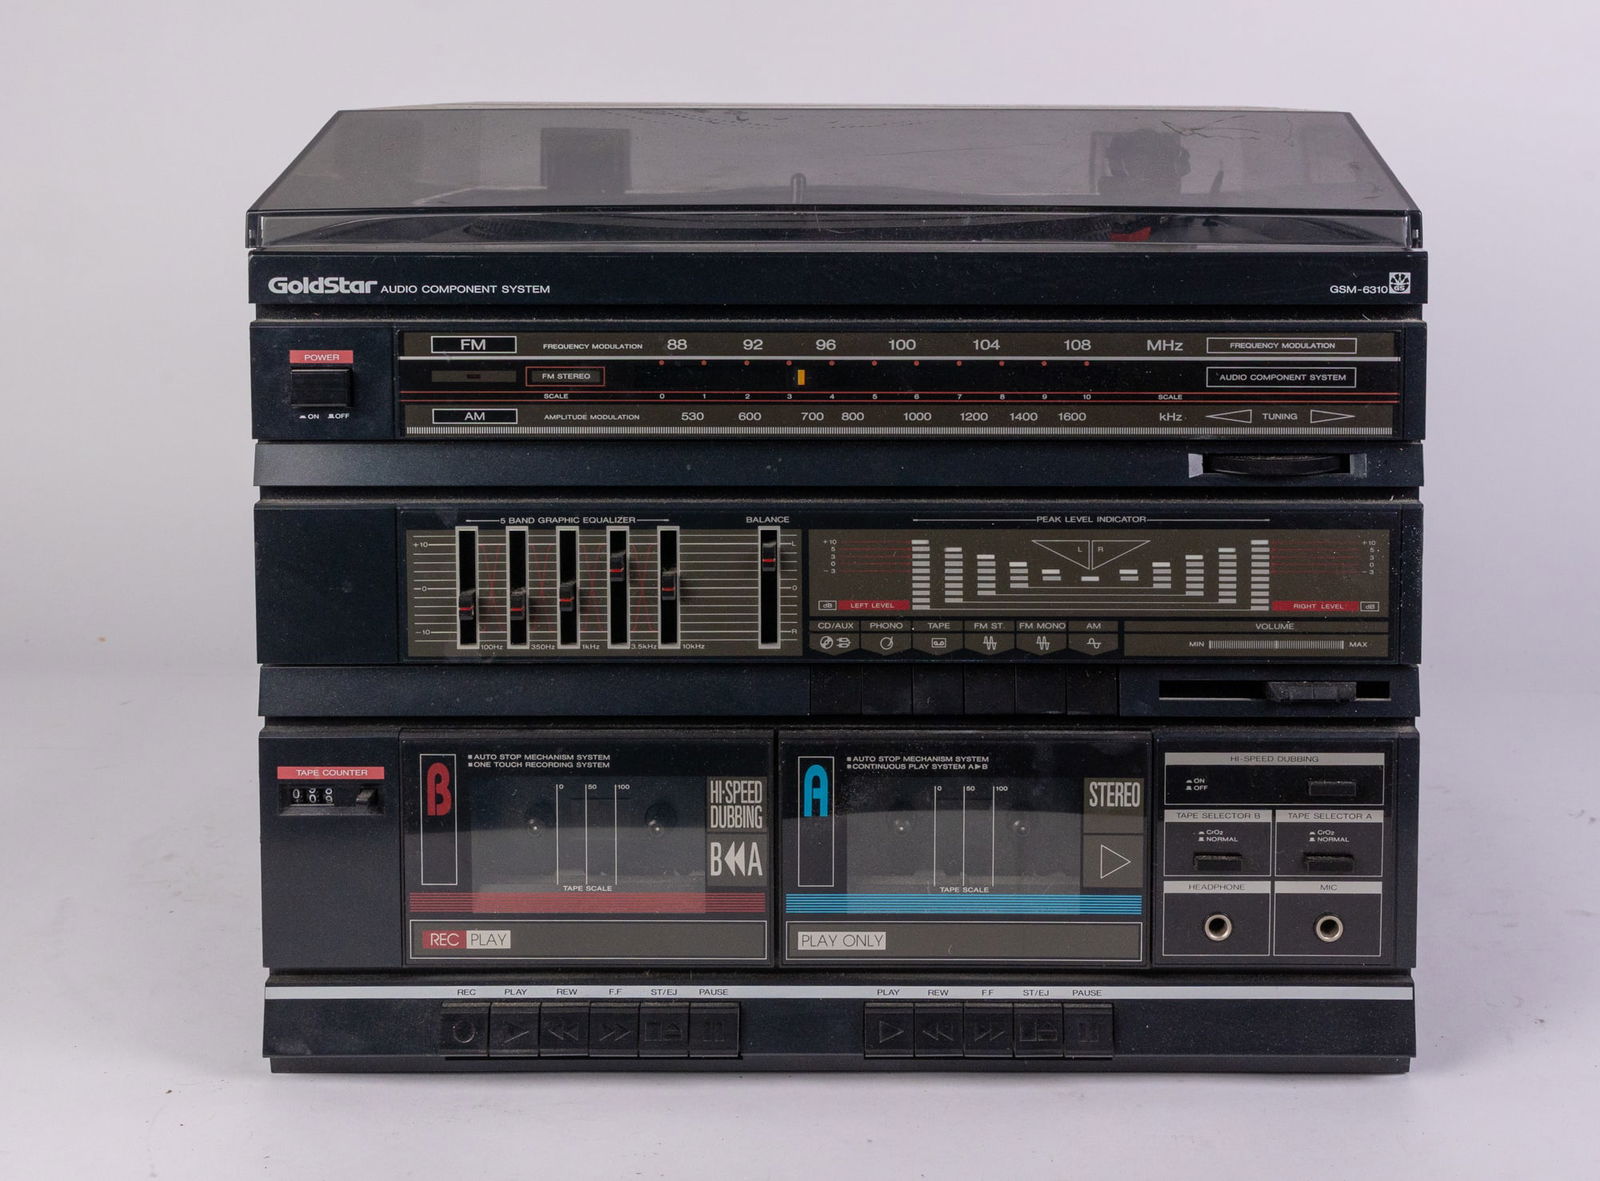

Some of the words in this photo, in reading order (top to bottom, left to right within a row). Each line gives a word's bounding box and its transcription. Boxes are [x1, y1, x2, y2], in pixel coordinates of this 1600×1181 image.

[268, 277, 378, 294] GoldStar
[380, 285, 417, 294] AUDIO
[422, 285, 497, 294] COMPONENT
[501, 285, 550, 294] SYSTEM
[1330, 285, 1388, 294] GSM-6310
[460, 339, 486, 351] FM
[543, 343, 589, 351] FREQUENCY
[667, 339, 688, 351] 88
[743, 339, 763, 351] 92
[816, 339, 836, 351] 96
[888, 339, 916, 351] 100
[972, 339, 1000, 351] 104
[1064, 339, 1091, 351] 108
[1146, 339, 1184, 351] MHz
[1230, 342, 1279, 350] FREQUENCY
[1281, 342, 1336, 350] MODULATION
[304, 353, 340, 361] POWER
[335, 412, 350, 420] OFF
[464, 412, 486, 421] AM
[544, 413, 588, 421] AMPLITUDE
[590, 413, 640, 421] MODULATION
[681, 412, 704, 421] 530
[738, 412, 761, 421] 600
[802, 412, 824, 421] 700
[841, 412, 864, 421] 800
[903, 412, 932, 421] 1000
[960, 412, 989, 421] 1200
[1009, 412, 1038, 421] 1400
[1058, 412, 1087, 421] 1600
[1159, 412, 1183, 422] kHz
[1262, 412, 1298, 421] TUNING
[582, 516, 636, 524] EQUALIZER
[746, 516, 790, 524] BALANCE
[818, 622, 854, 630] CD/AUX
[869, 622, 904, 630] PHONO
[927, 622, 950, 630] TAPE
[1036, 622, 1067, 630] MONO
[1086, 622, 1101, 630] AM
[1255, 622, 1295, 630] VOLUME
[296, 769, 320, 777] TAPE
[322, 769, 368, 777] COUNTER
[427, 762, 452, 816] B
[804, 764, 828, 817] A
[1089, 782, 1141, 807] STEREO
[710, 805, 763, 828] DUBBING
[430, 933, 460, 946] REC
[470, 932, 507, 946] PLAY
[801, 935, 837, 948] PLAY
[843, 934, 886, 948] ONLY
[457, 988, 476, 996] REC
[505, 988, 528, 996] PLAY
[556, 988, 578, 996] REW
[651, 988, 677, 996] ST/EJ
[699, 988, 729, 996] PAUSE
[877, 989, 900, 997] PLAY
[928, 989, 949, 997] REW
[1023, 989, 1049, 997] ST/EJ
[1072, 989, 1103, 997] PAUSE
